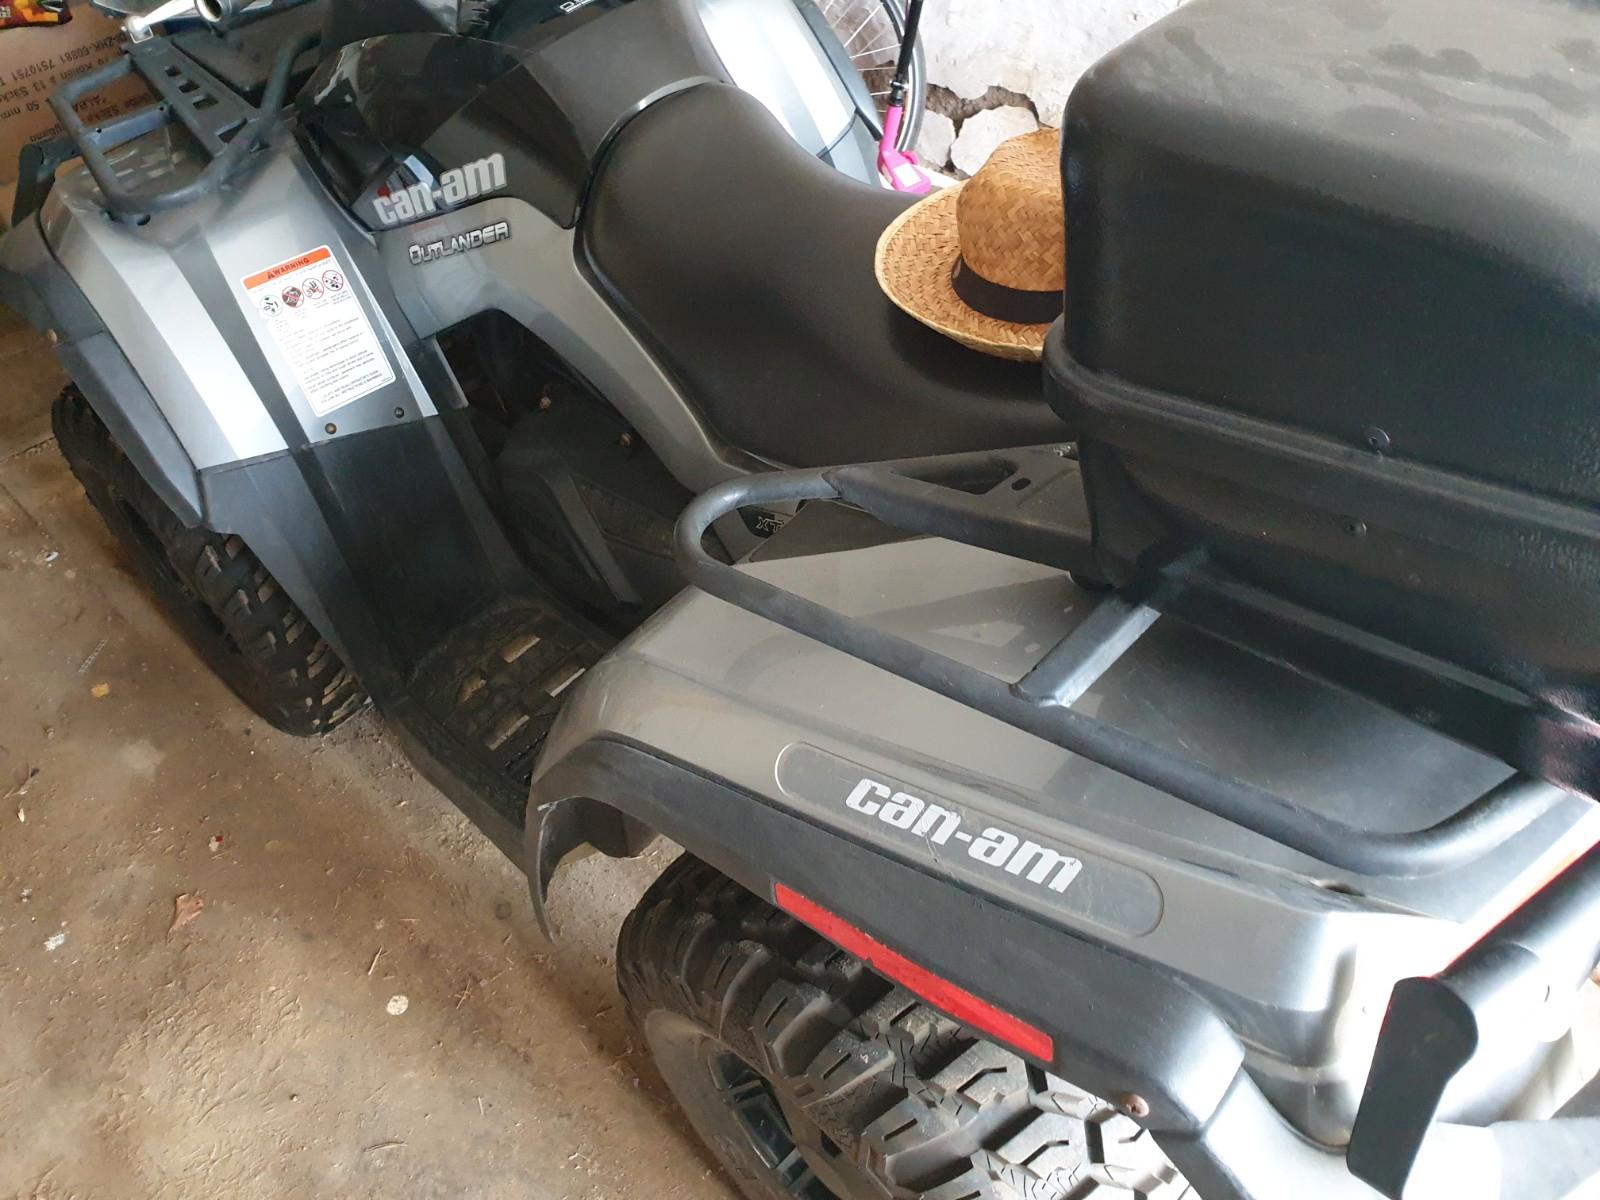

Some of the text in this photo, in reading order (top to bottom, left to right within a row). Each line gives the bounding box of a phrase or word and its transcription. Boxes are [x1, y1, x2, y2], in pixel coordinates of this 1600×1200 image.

[26, 102, 40, 113] 50
[373, 153, 507, 225] can-am
[409, 221, 510, 265] OUTLANDER
[275, 257, 310, 275] WARNING
[756, 516, 784, 533] XT
[845, 778, 1082, 893] can-am
